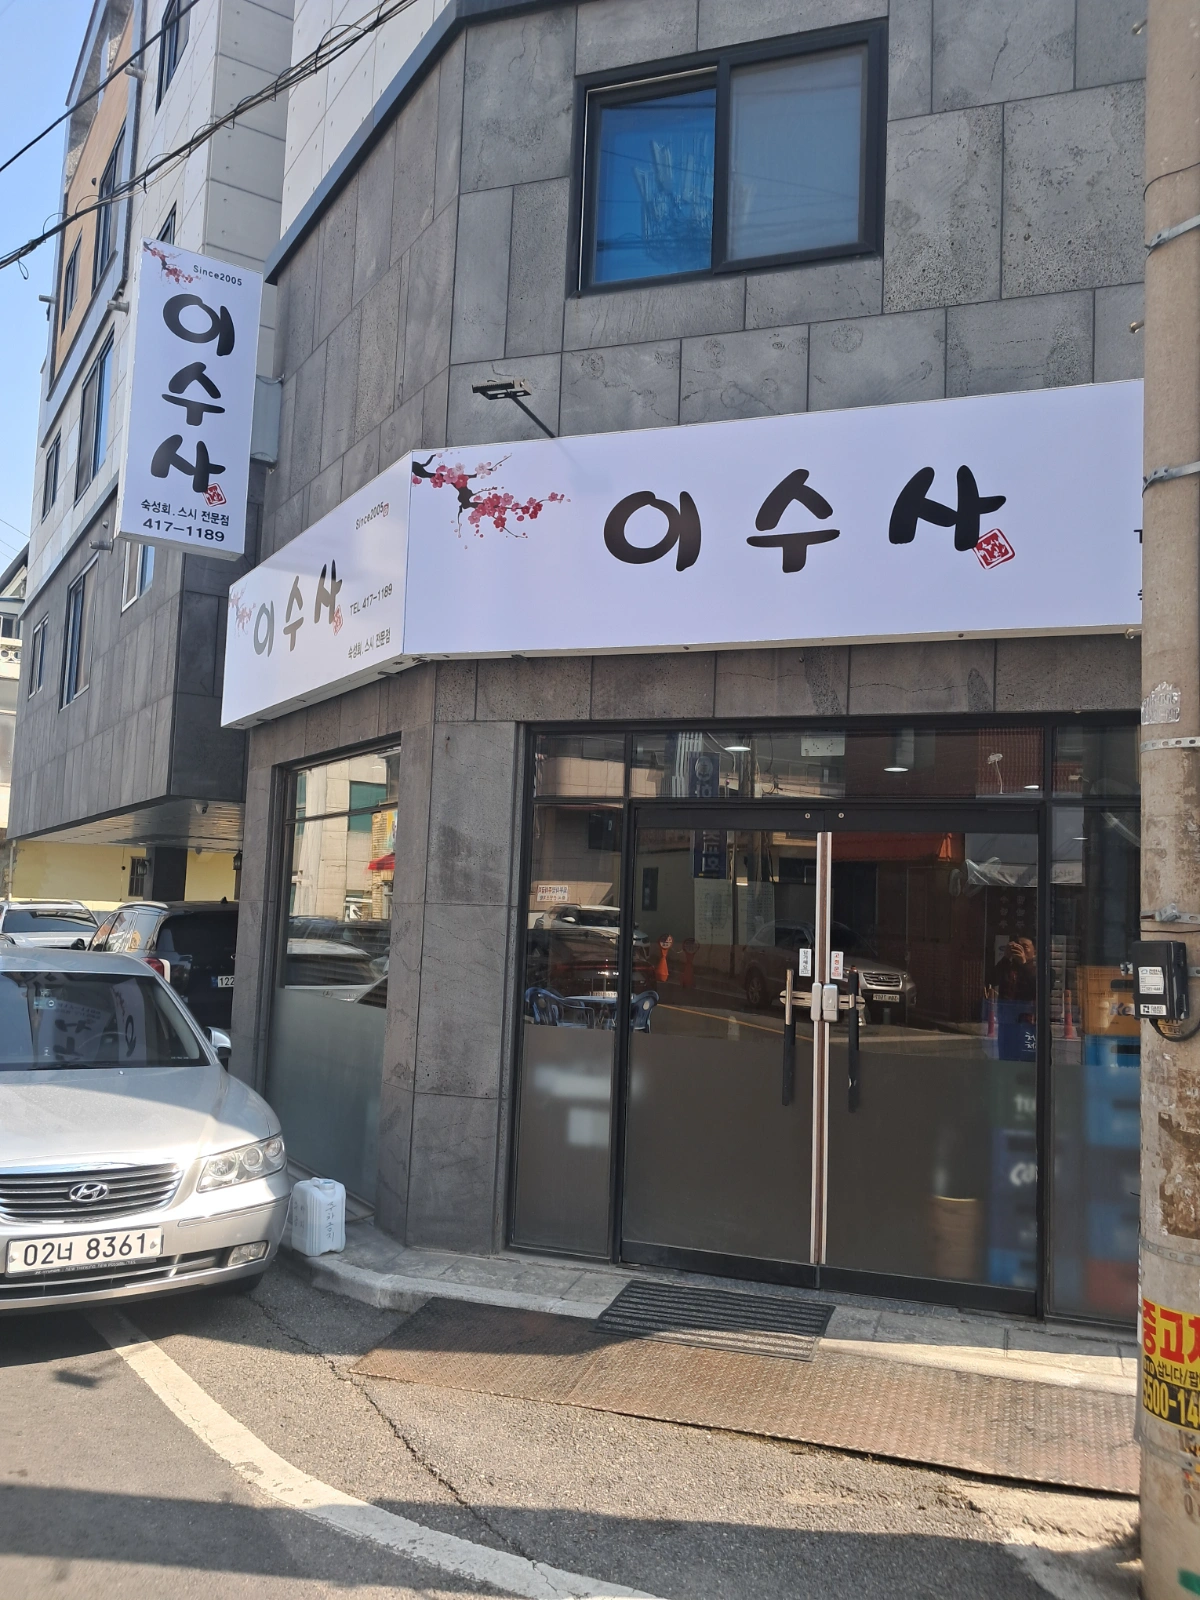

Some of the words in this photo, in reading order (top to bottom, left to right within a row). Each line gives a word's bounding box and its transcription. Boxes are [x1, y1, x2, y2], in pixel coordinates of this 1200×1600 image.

[192, 264, 243, 287] Since2005
[200, 510, 230, 526] 전문점
[355, 501, 384, 530] Since2005
[142, 518, 225, 543] 417-1189
[349, 604, 361, 617] TEL
[361, 583, 393, 610] 417-1189
[375, 627, 391, 647] 전문점
[23, 1242, 73, 1267] 02너
[85, 1232, 147, 1260] 8361
[1157, 1361, 1200, 1388] 삽니다/팝
[1143, 1376, 1200, 1428] 5500-14
